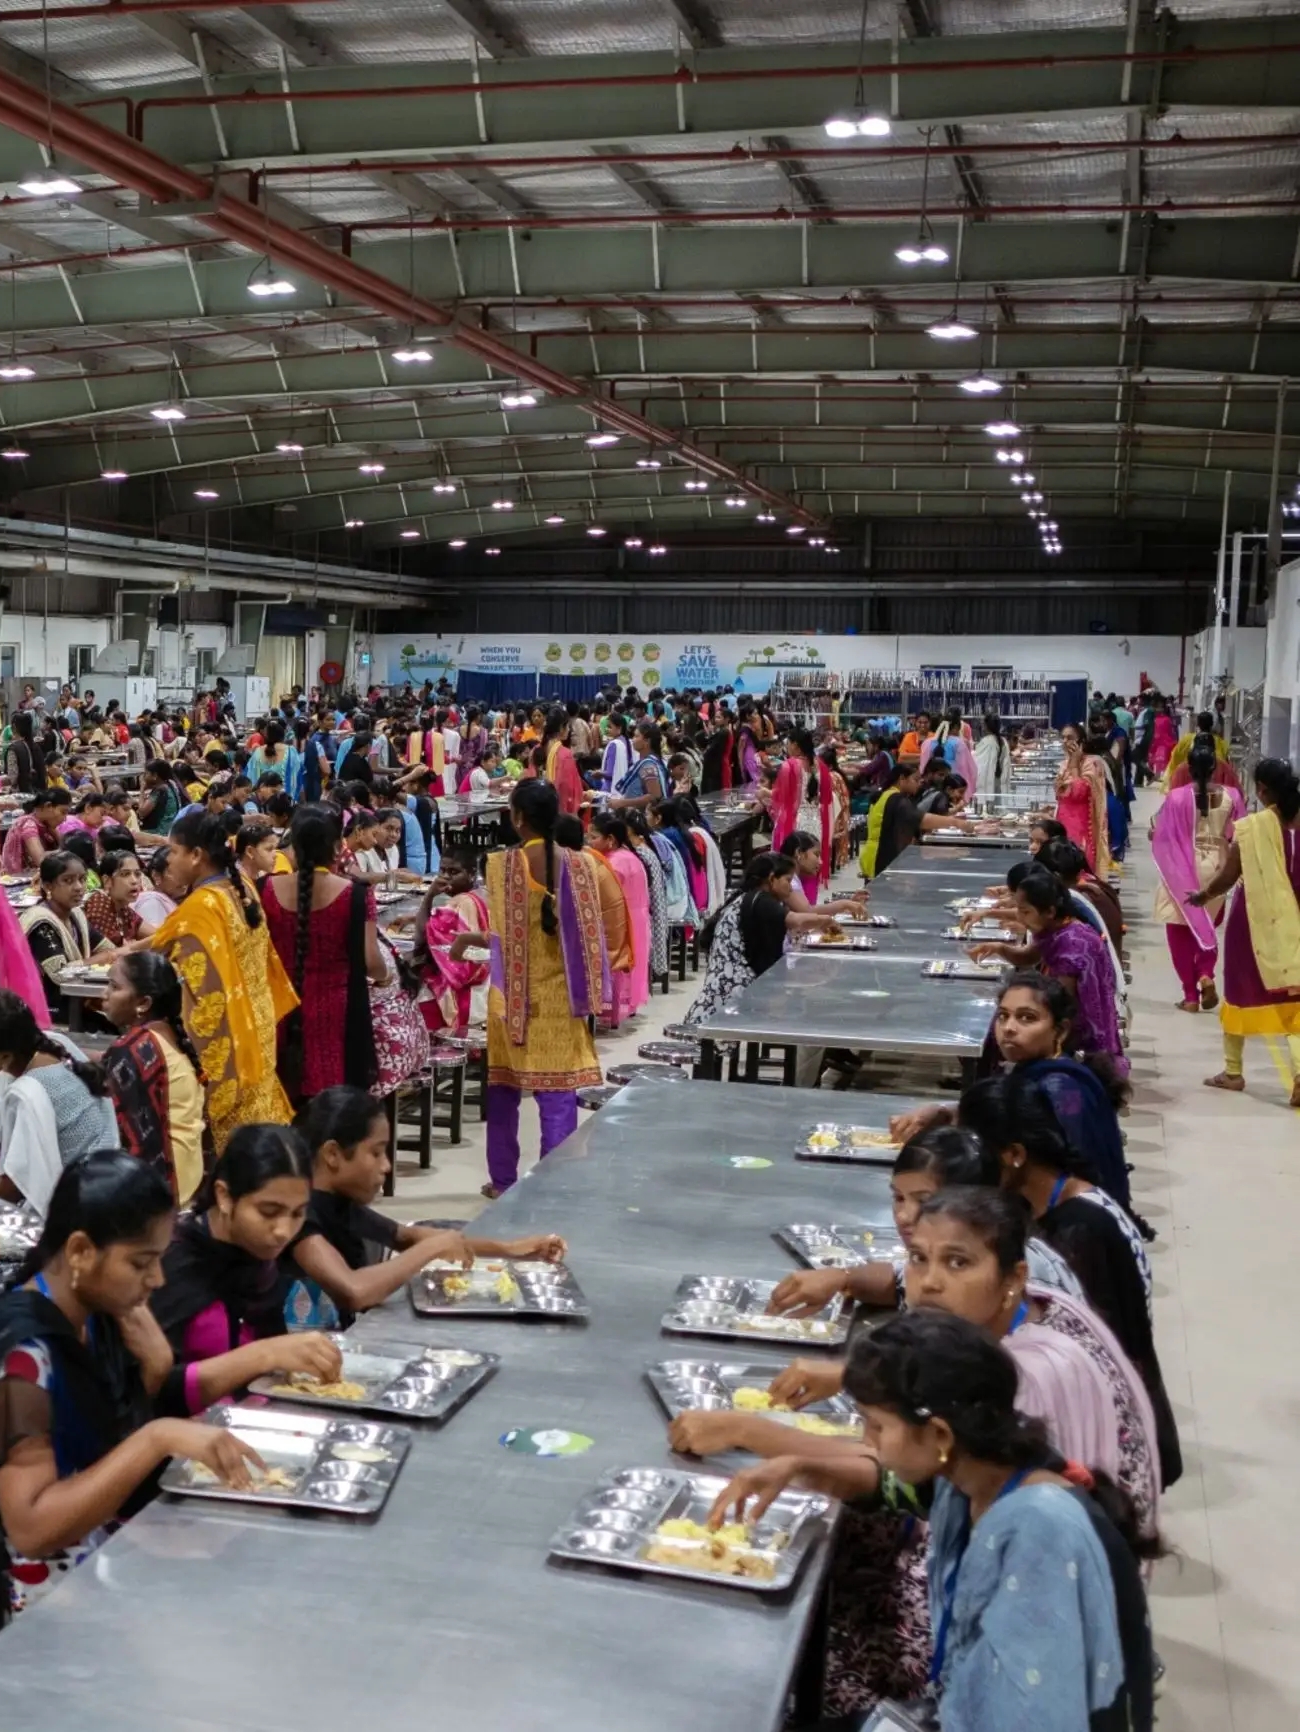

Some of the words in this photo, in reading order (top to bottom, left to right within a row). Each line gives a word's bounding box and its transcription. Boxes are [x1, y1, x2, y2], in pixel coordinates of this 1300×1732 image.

[480, 646, 503, 654] WHEN
[505, 646, 521, 654] YOU
[684, 645, 712, 654] LET'S
[480, 655, 520, 663] CONSERVE
[679, 655, 717, 667] SAVE
[676, 667, 719, 679] WATER
